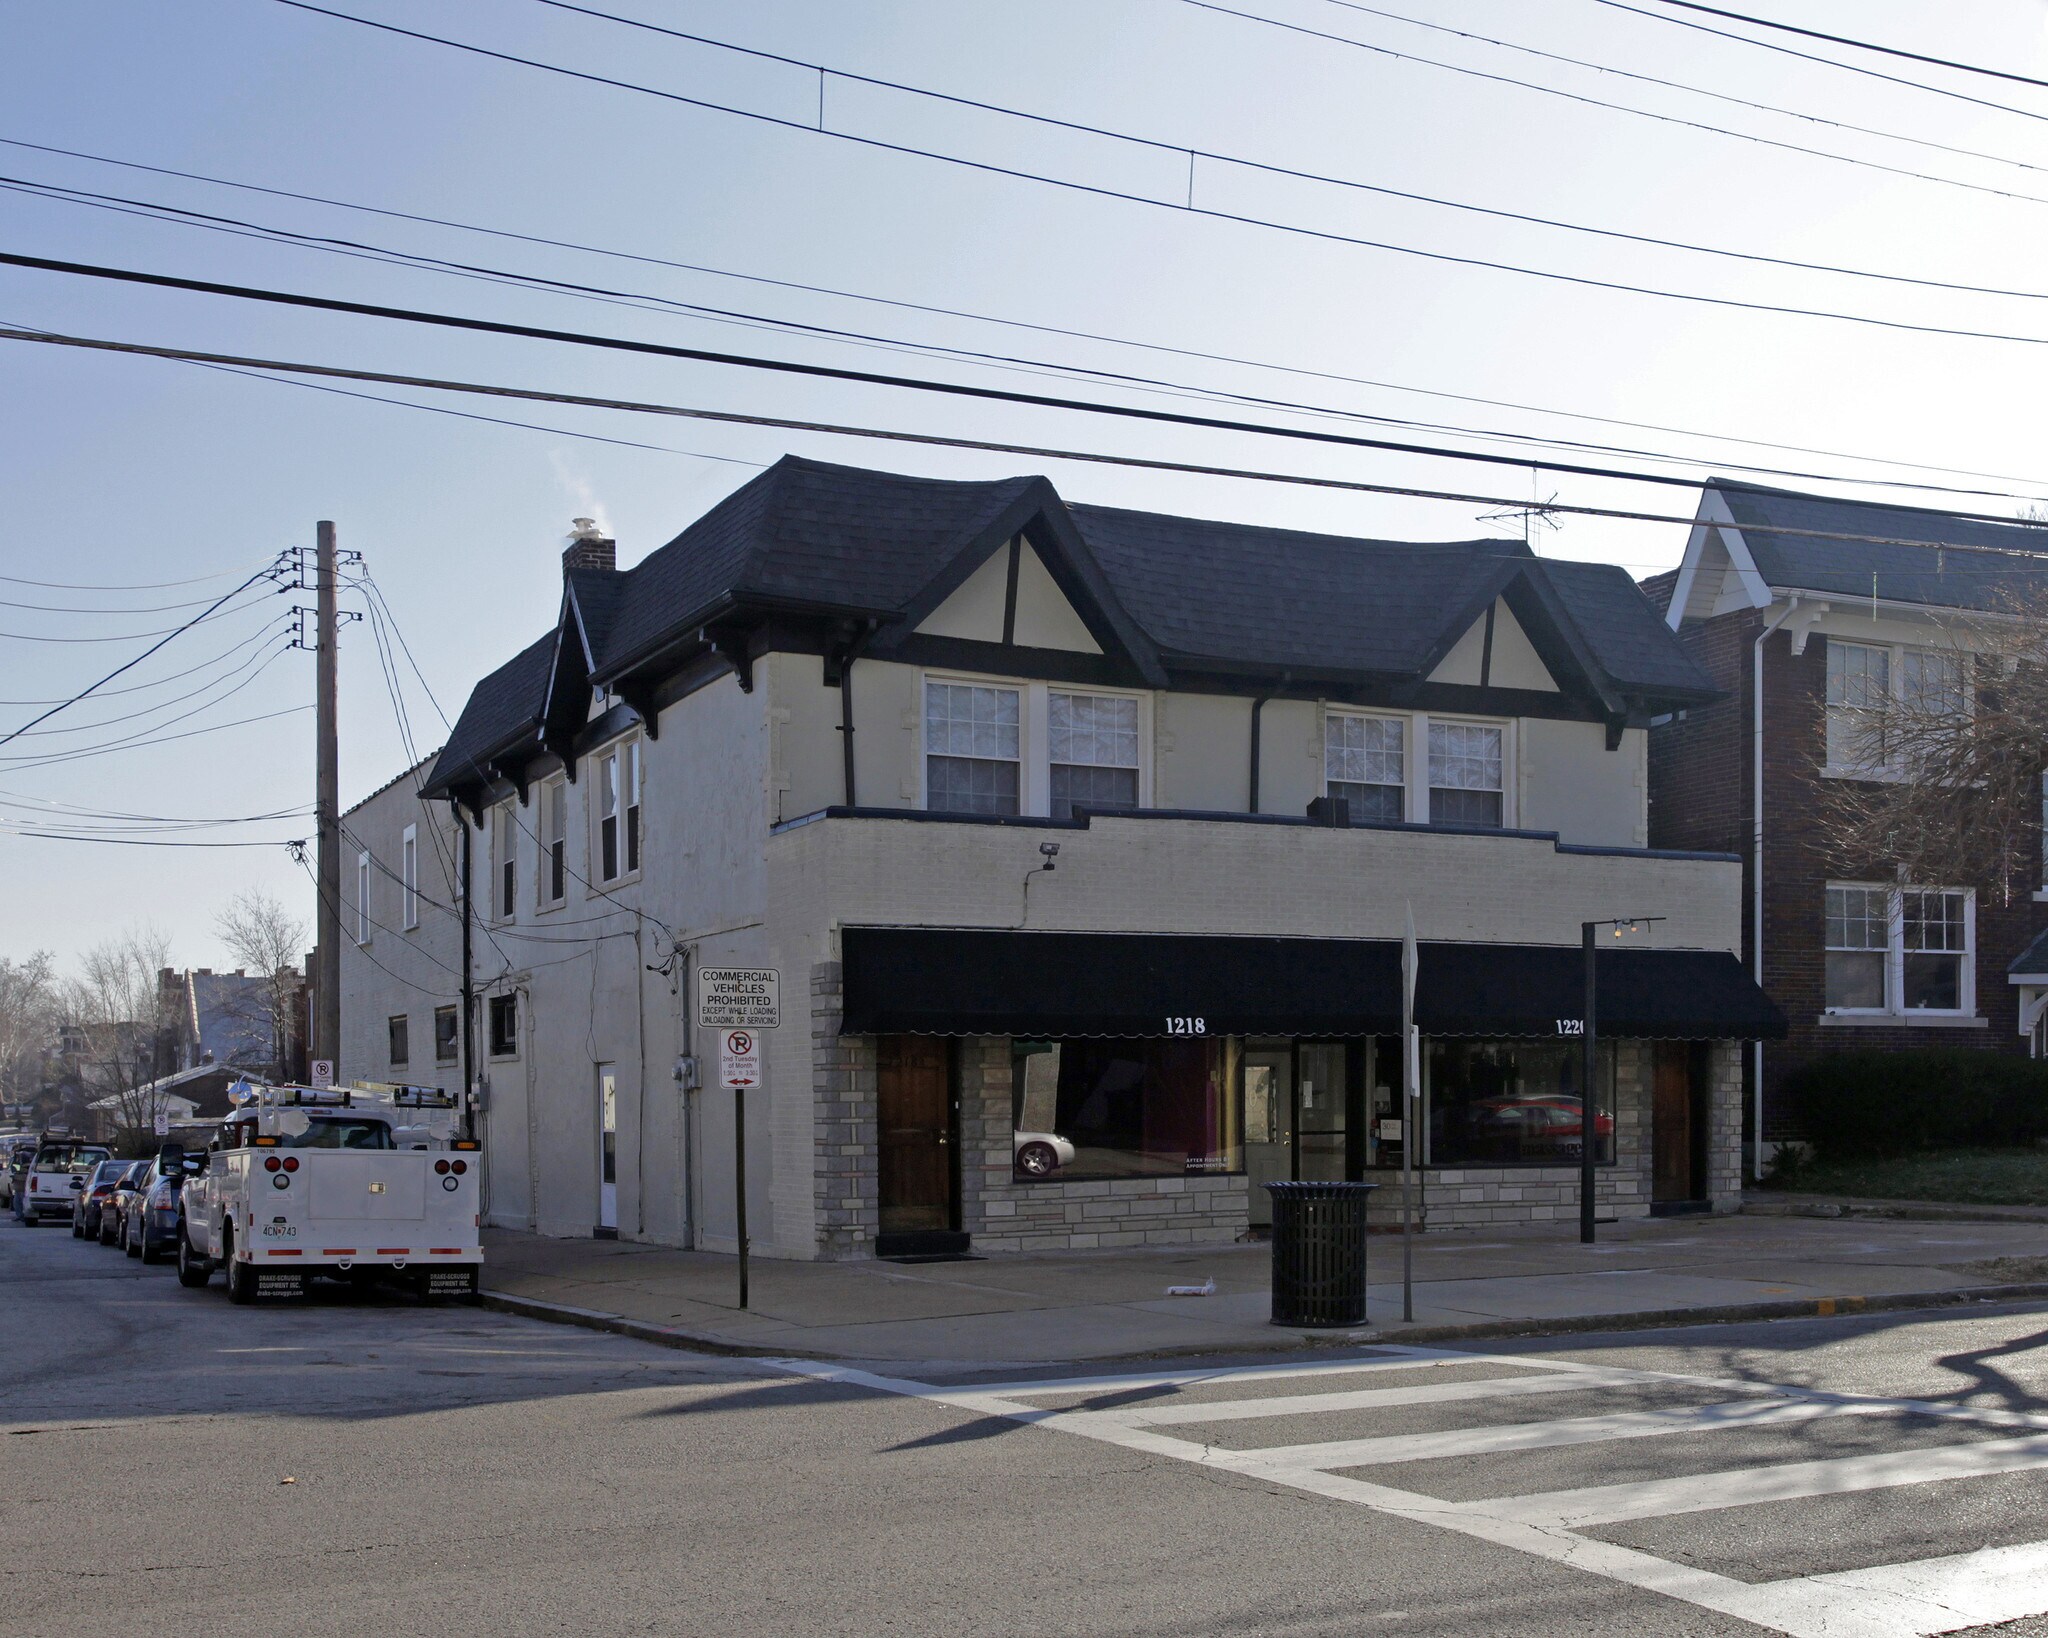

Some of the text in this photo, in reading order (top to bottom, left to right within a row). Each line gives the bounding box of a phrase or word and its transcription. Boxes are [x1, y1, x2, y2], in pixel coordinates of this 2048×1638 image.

[702, 971, 775, 982] COMMERCIAL
[713, 983, 765, 994] VEHICLES
[707, 995, 771, 1006] PROHIBITED
[702, 1006, 777, 1016] EXCEPT WHILE LOADING
[702, 1016, 777, 1025] UNLOADING OR SERVICING
[1165, 1017, 1206, 1034] 1218
[735, 1055, 758, 1063] Tuesday
[258, 1281, 289, 1289] EQUIPMENT
